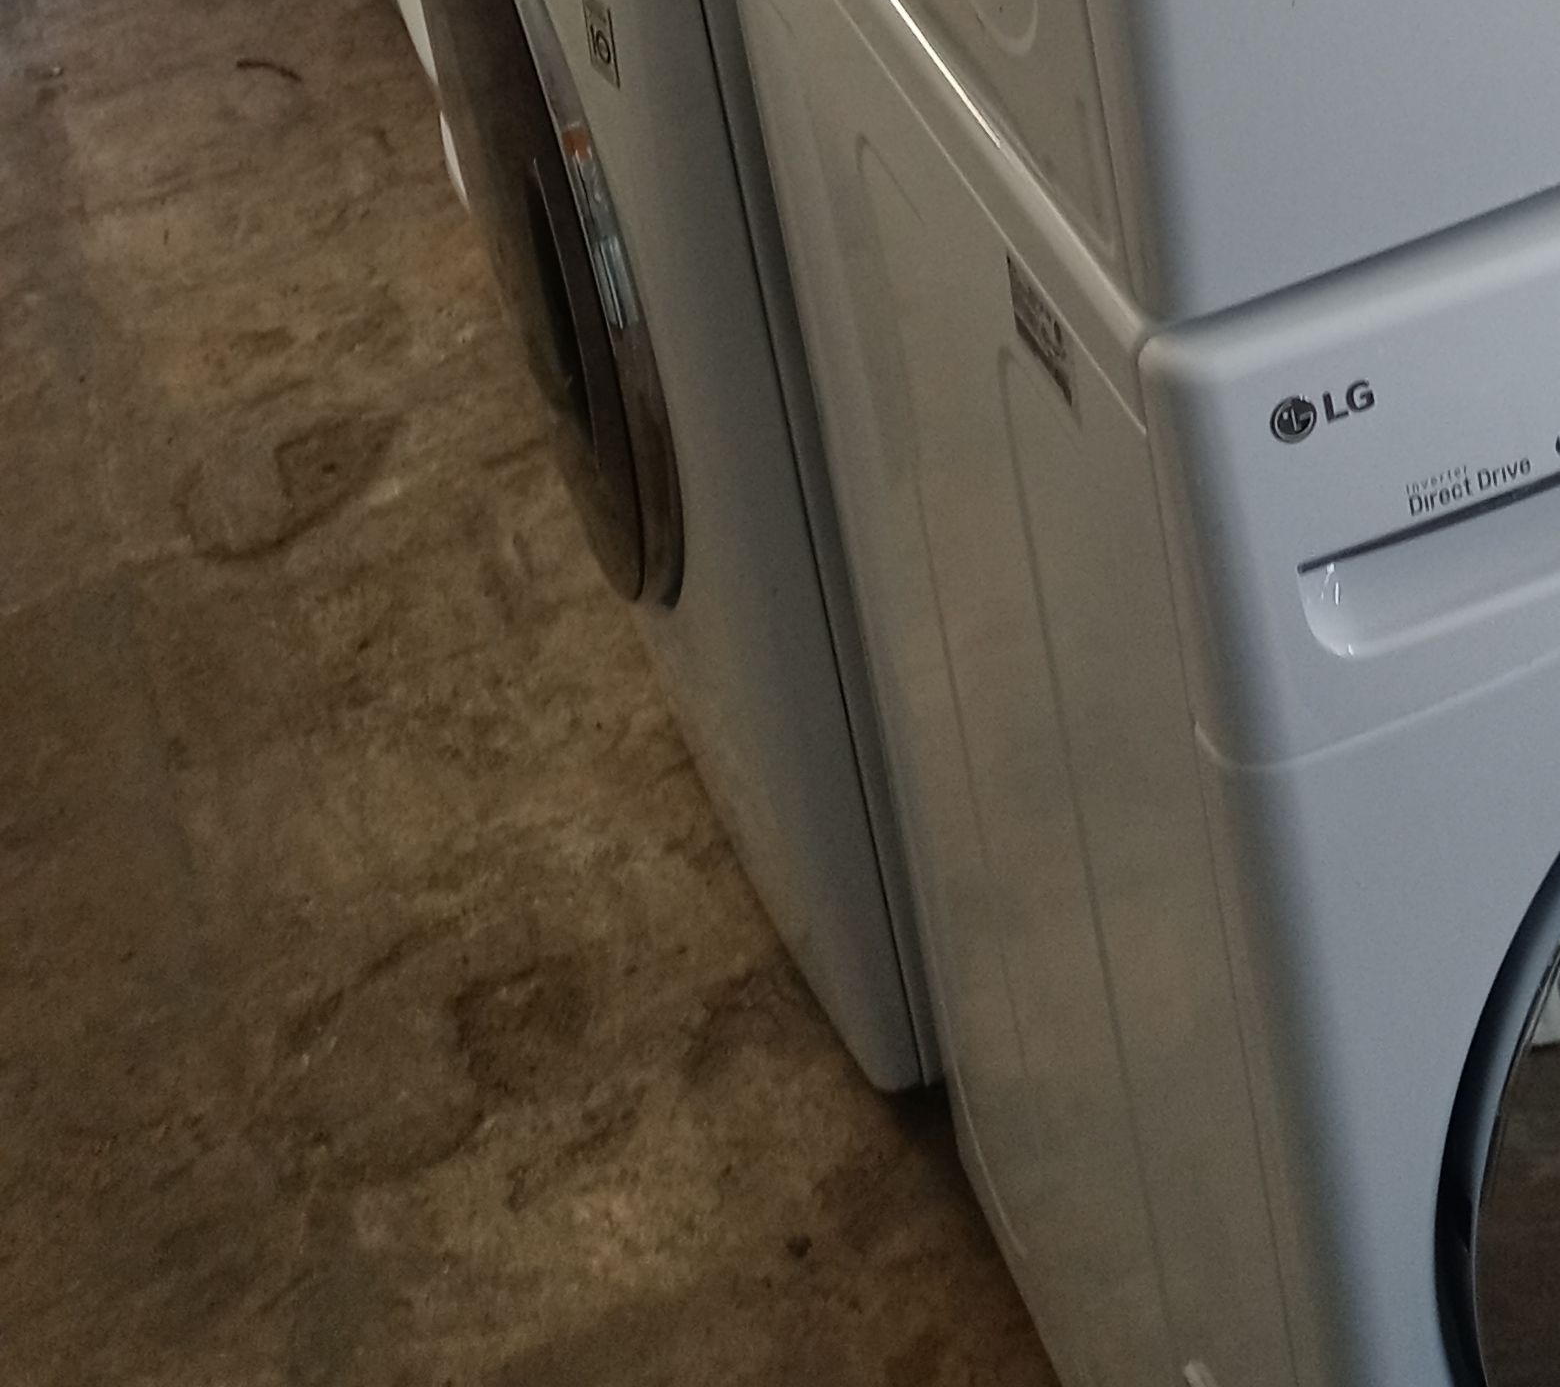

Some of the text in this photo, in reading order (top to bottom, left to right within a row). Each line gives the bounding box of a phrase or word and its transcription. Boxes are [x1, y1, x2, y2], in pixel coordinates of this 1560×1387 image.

[1322, 379, 1375, 424] LG
[1405, 465, 1467, 494] Inverter
[1408, 457, 1532, 517] Direct Drive
